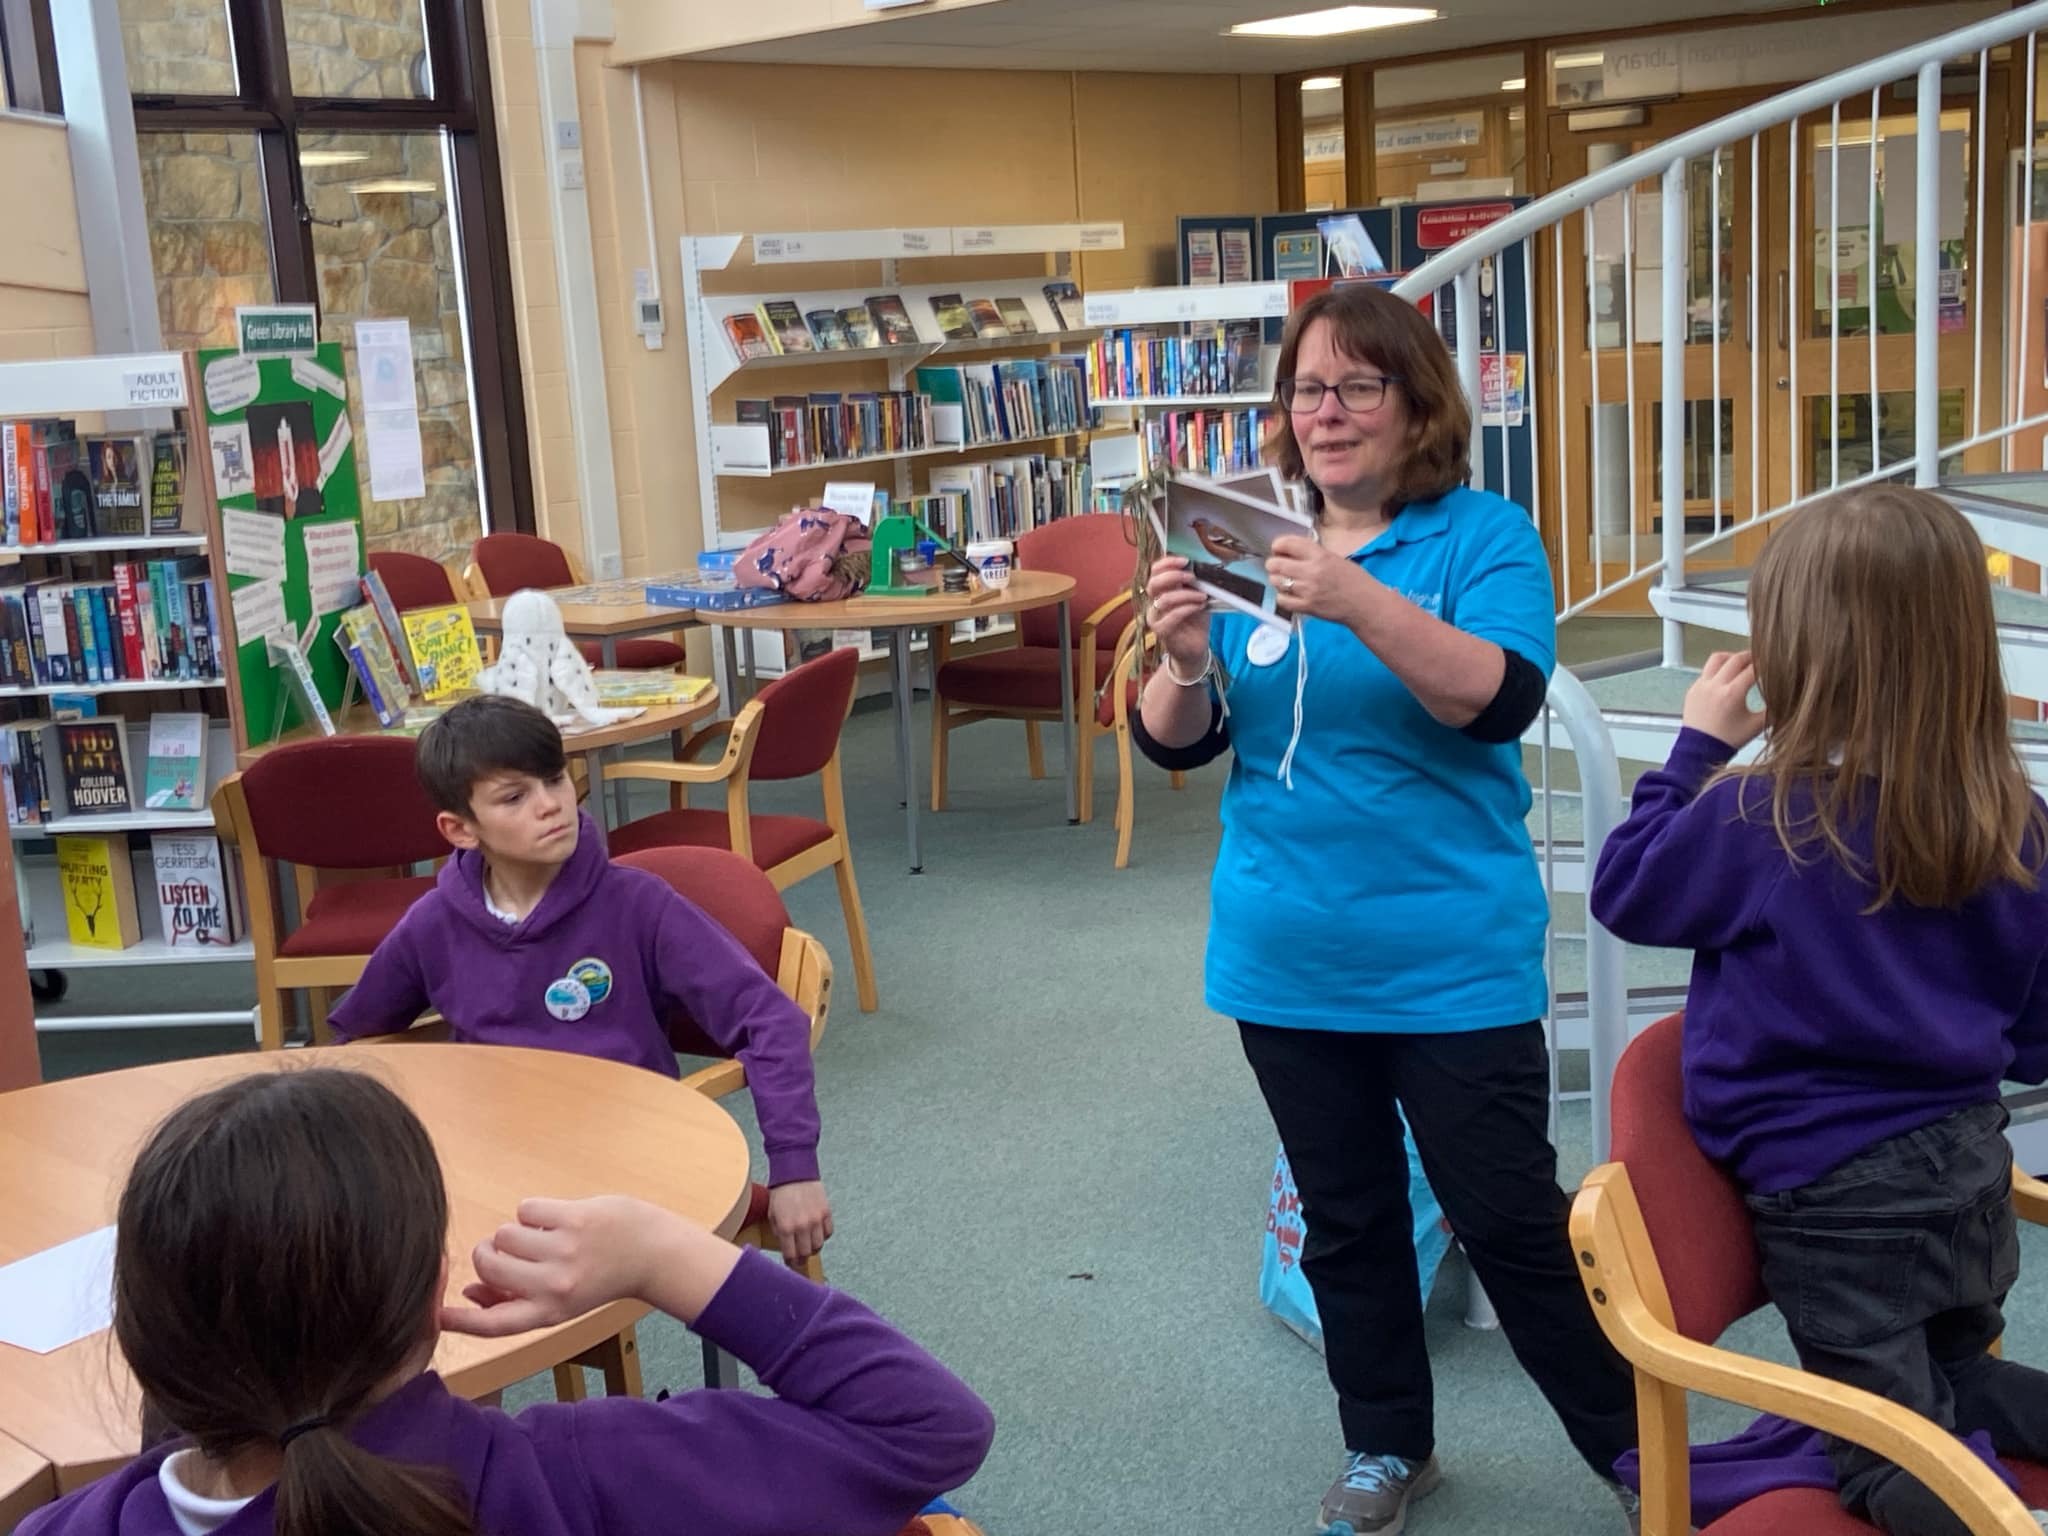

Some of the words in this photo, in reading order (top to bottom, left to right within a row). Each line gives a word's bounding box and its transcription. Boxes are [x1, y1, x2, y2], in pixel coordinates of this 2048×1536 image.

[247, 323, 271, 340] Green
[271, 322, 297, 343] Library
[298, 321, 312, 338] Hub
[136, 372, 176, 386] ADULT
[130, 387, 179, 401] FICTION
[113, 564, 132, 601] HILL
[120, 609, 136, 637] 112
[80, 776, 116, 788] COLLEEN
[73, 787, 127, 807] HOOVER
[170, 843, 197, 856] TESS
[60, 862, 108, 877] HUNTING
[155, 856, 216, 870] GERRITSEN
[161, 884, 210, 906] LISTEN
[174, 906, 193, 928] TO
[197, 906, 222, 929] ME
